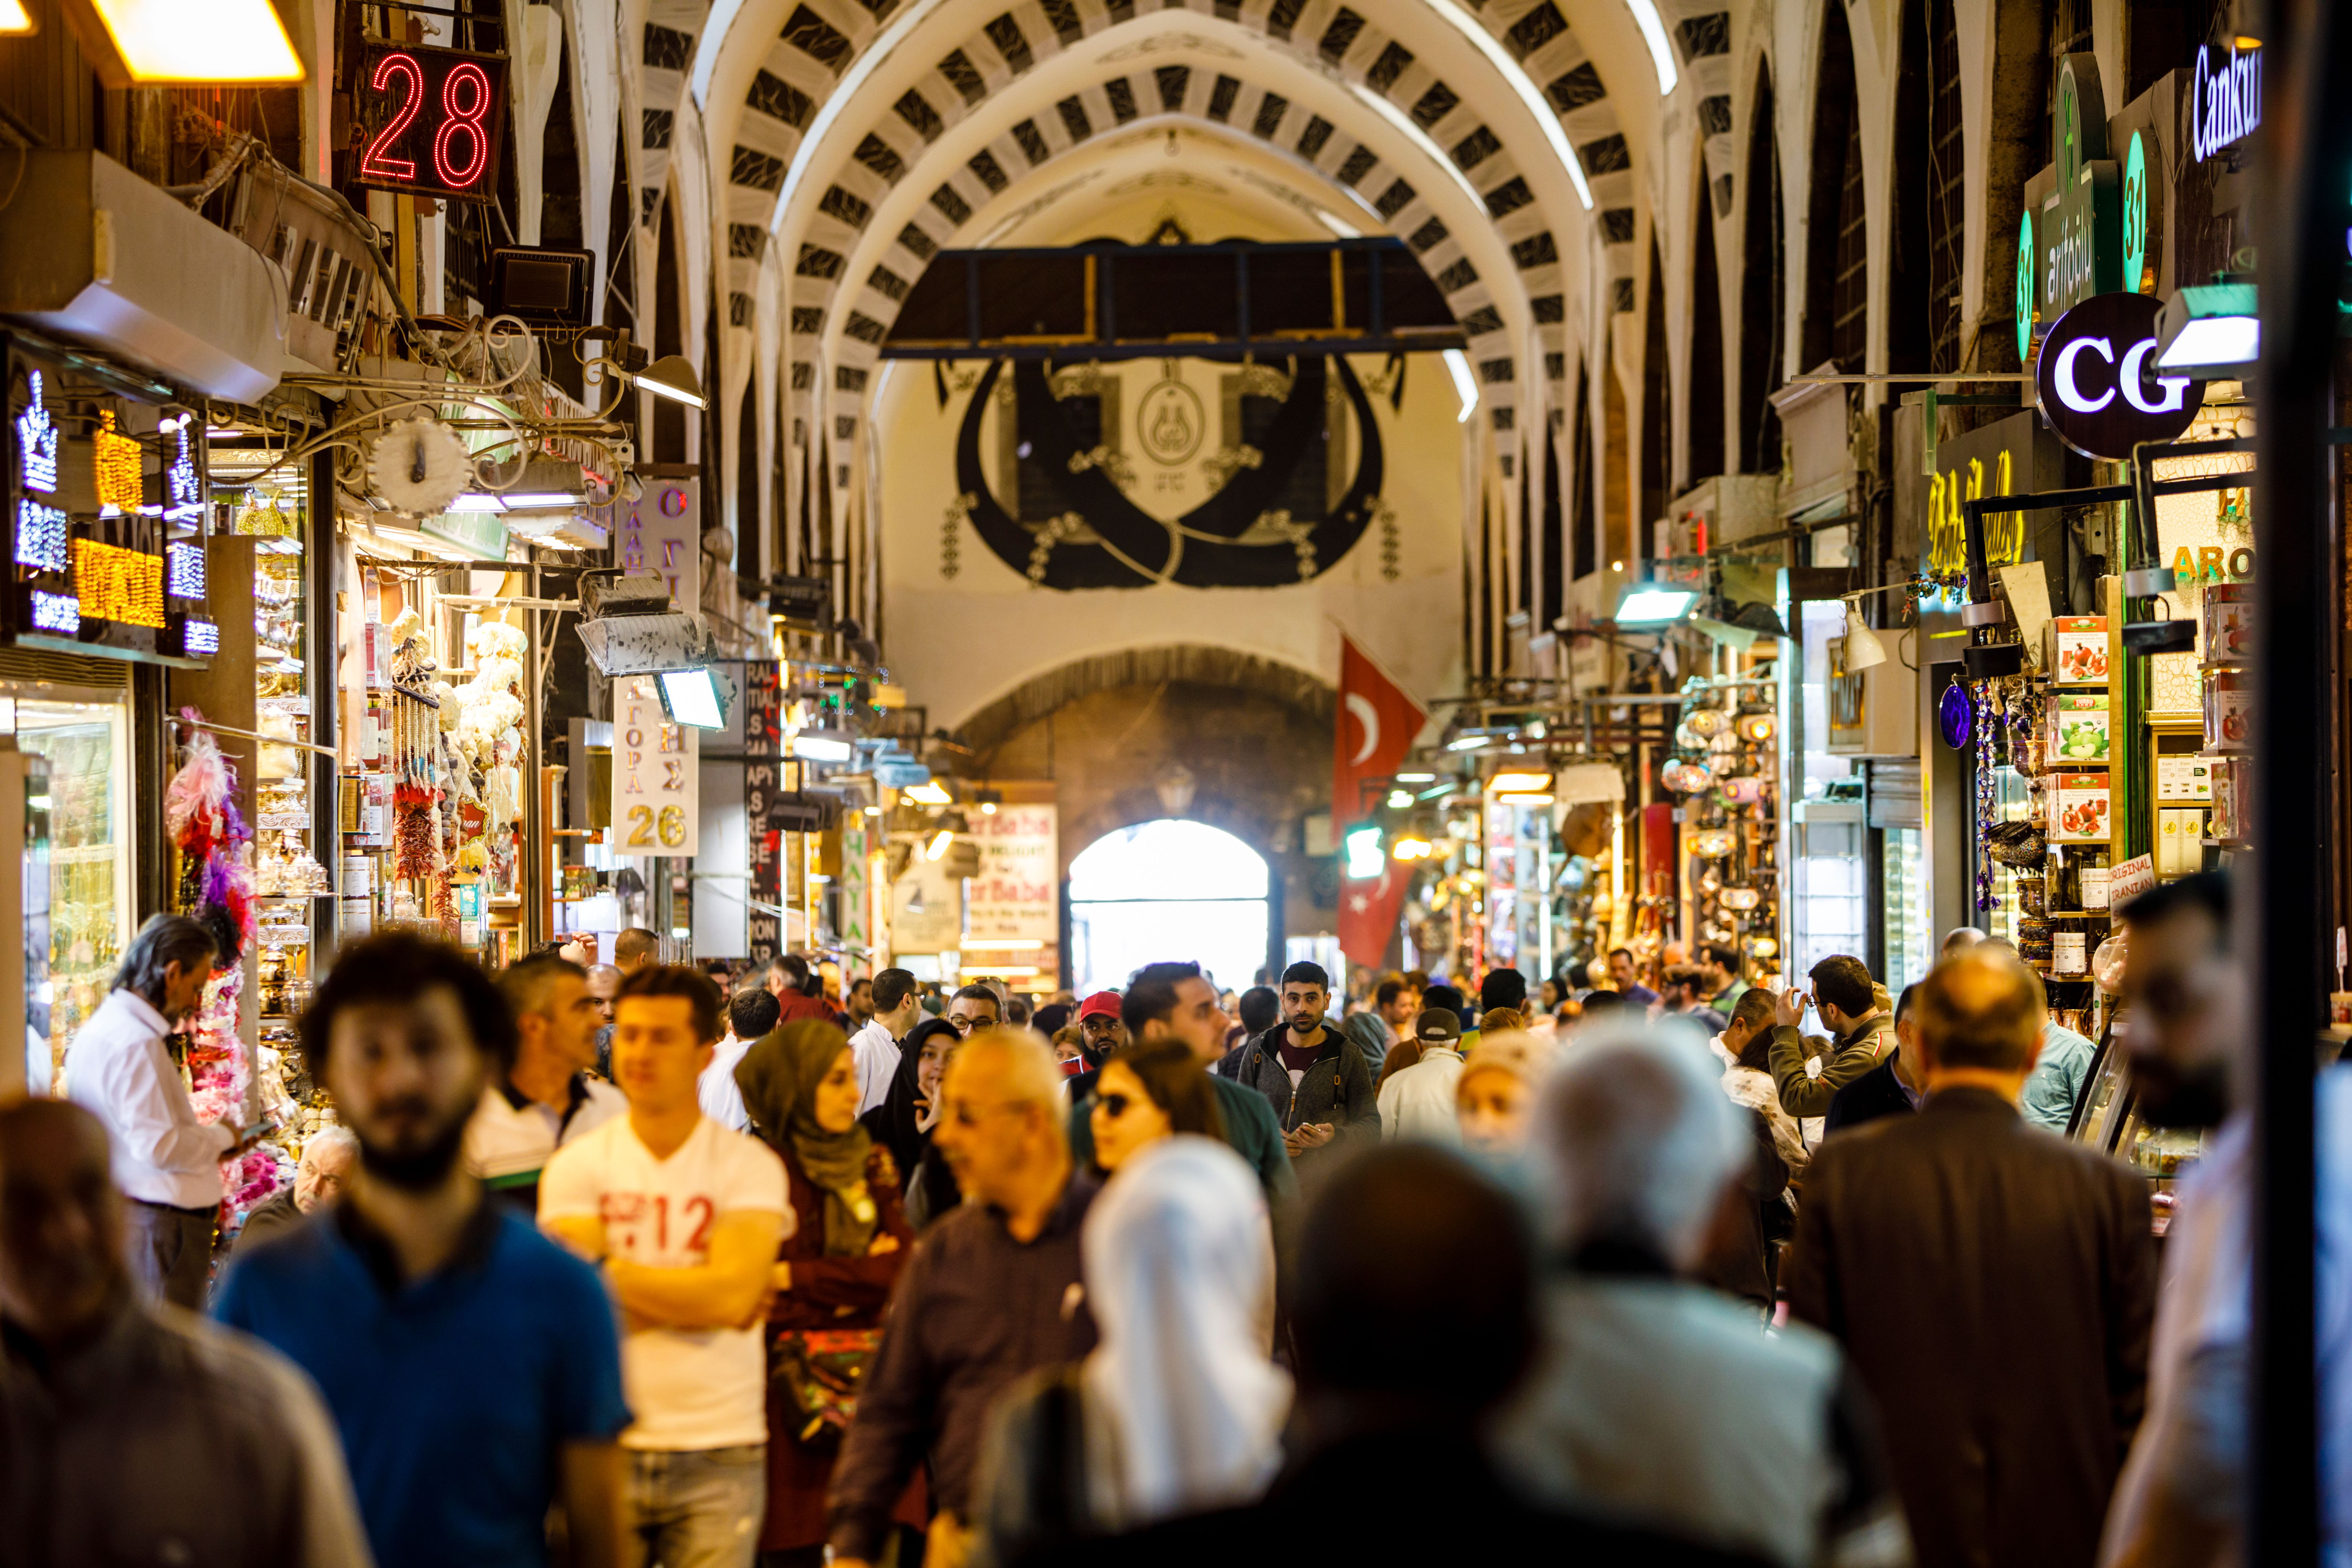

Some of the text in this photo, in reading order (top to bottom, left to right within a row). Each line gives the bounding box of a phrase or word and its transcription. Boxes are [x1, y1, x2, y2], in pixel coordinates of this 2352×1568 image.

[363, 54, 489, 186] 28
[2126, 168, 2143, 261] 31
[2018, 244, 2032, 324] 31
[2054, 336, 2191, 414] CG
[627, 804, 686, 849] 26
[2109, 858, 2151, 883] ORIGINAL
[2111, 877, 2153, 902] IRANIAN
